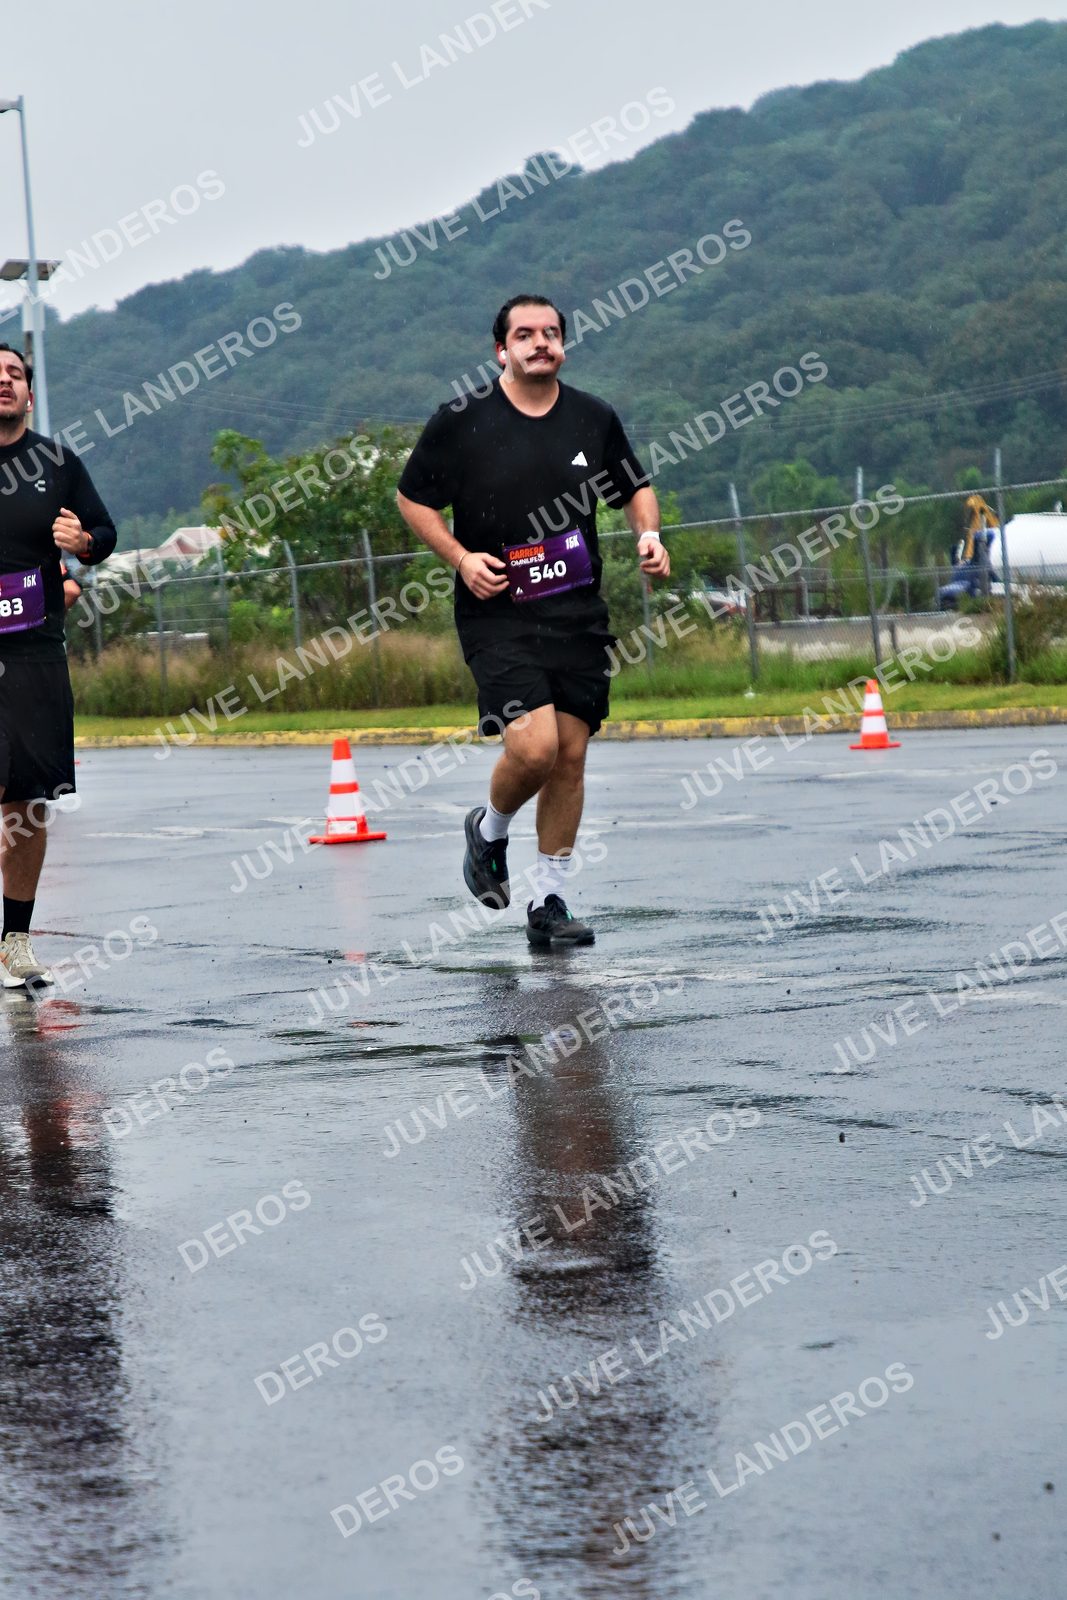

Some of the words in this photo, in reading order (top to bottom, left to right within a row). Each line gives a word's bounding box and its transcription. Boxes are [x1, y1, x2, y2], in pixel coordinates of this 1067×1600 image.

[509, 545, 544, 560] CARRERA
[529, 560, 567, 584] 540
[0, 598, 24, 618] 83
